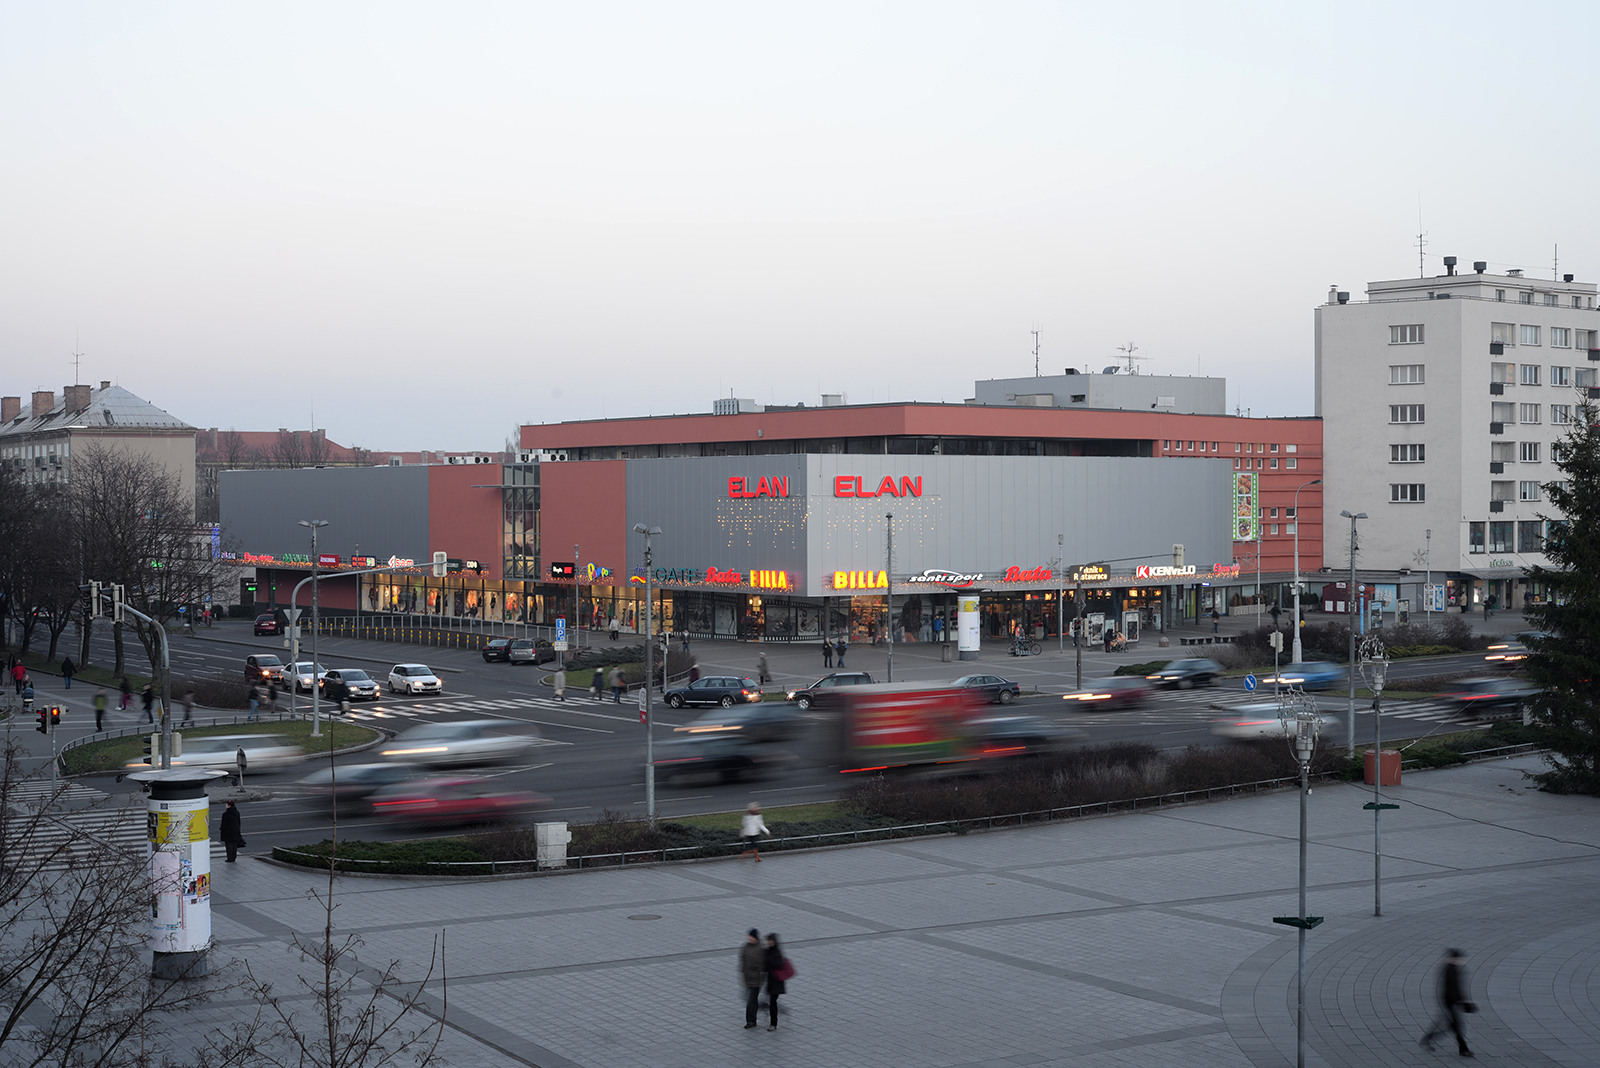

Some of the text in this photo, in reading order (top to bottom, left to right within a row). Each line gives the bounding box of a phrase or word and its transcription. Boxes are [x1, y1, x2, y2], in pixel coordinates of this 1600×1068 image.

[728, 476, 788, 498] ELAN
[834, 475, 922, 497] ELAN
[654, 567, 697, 583] GATE
[750, 570, 788, 588] BILLA
[834, 570, 888, 588] BILLA
[1073, 572, 1107, 581] Rstaurace
